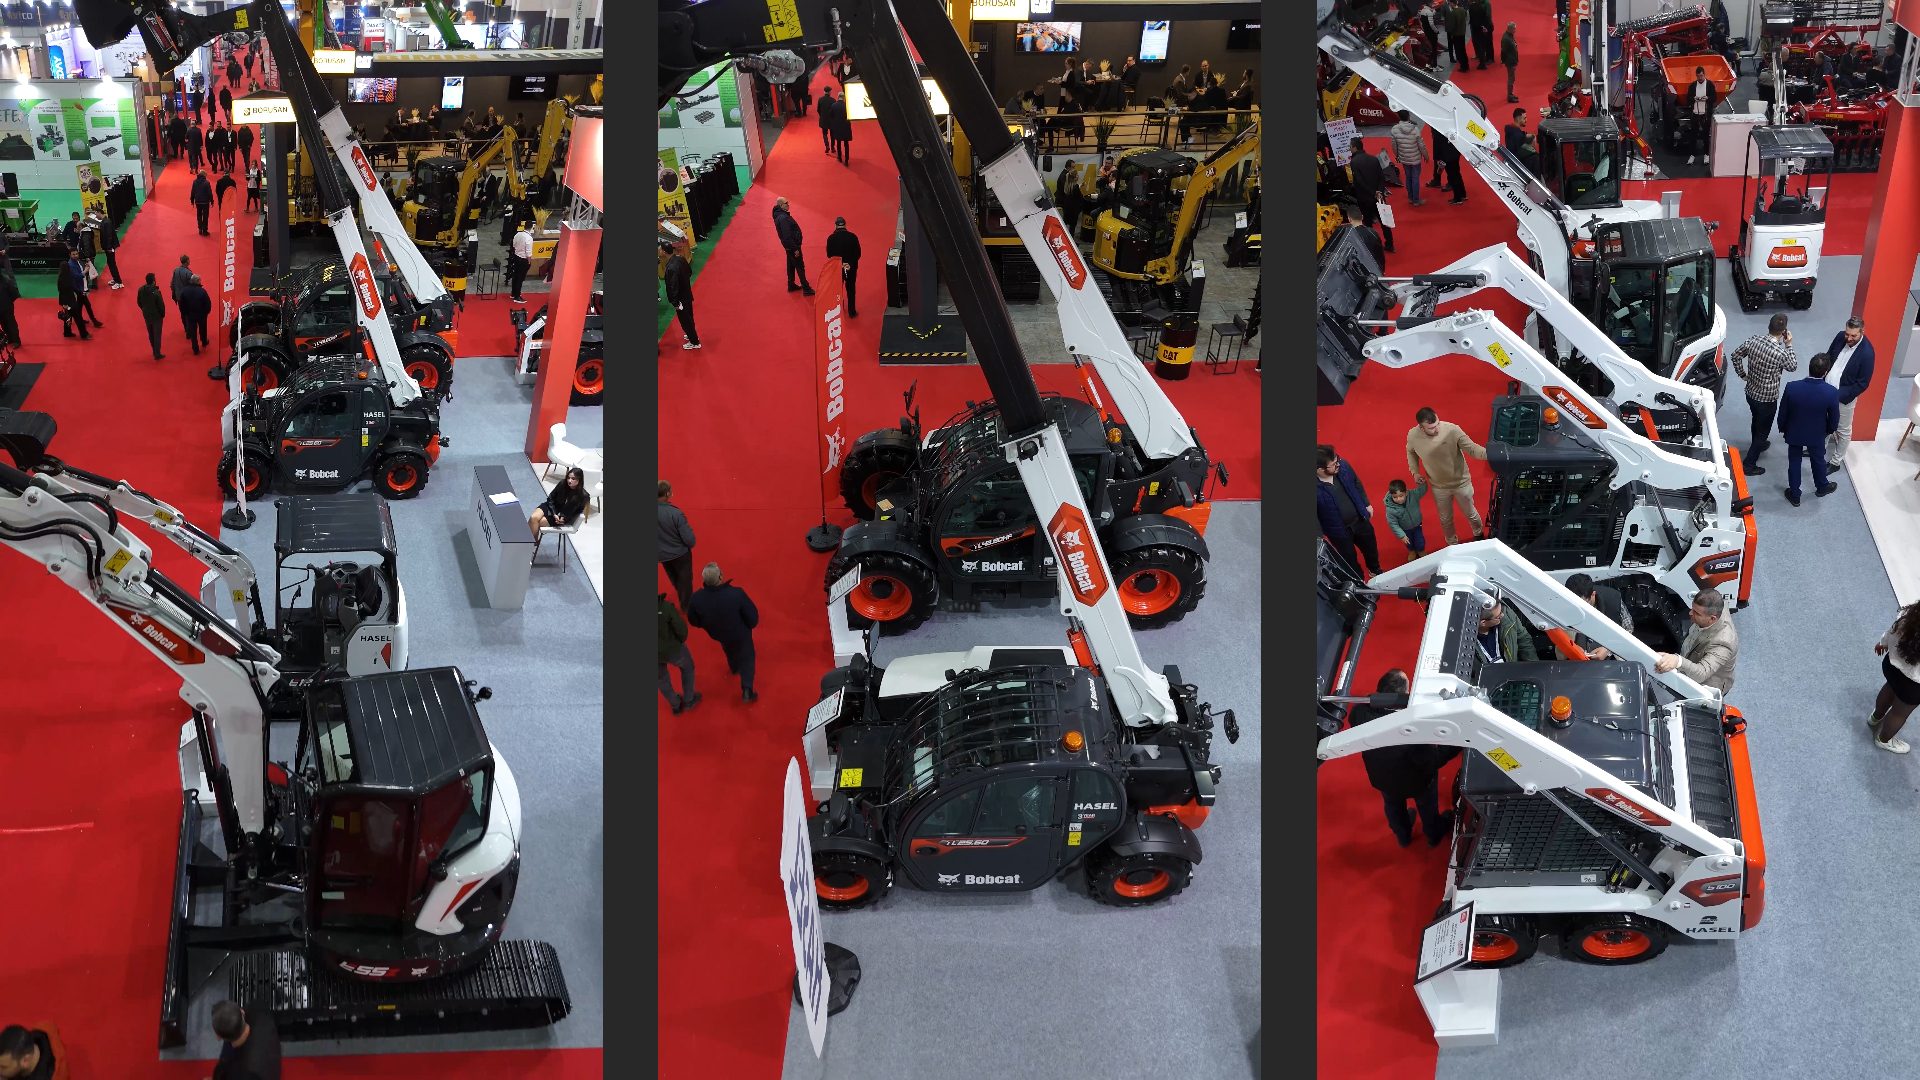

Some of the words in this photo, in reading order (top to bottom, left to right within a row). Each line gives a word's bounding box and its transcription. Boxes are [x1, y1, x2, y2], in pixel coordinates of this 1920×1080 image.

[1507, 190, 1532, 215] Bobcat
[224, 217, 234, 292] Bobcat
[1058, 250, 1079, 280] Bobcat
[445, 280, 455, 288] CAT
[359, 282, 375, 310] Bobcat
[825, 304, 844, 422] Bobcat
[1162, 349, 1178, 361] CAT
[1565, 401, 1588, 420] Bobcat
[309, 470, 339, 478] Bobcat
[211, 560, 229, 572] Bobcat
[981, 560, 1024, 572] Bobcat
[1067, 551, 1097, 592] Bobcat
[143, 624, 178, 651] Bobcat
[1088, 677, 1097, 701] Bobcat
[1074, 803, 1118, 811] HASEL
[1615, 801, 1644, 817] Bobcat
[965, 874, 1021, 885] Bobcat
